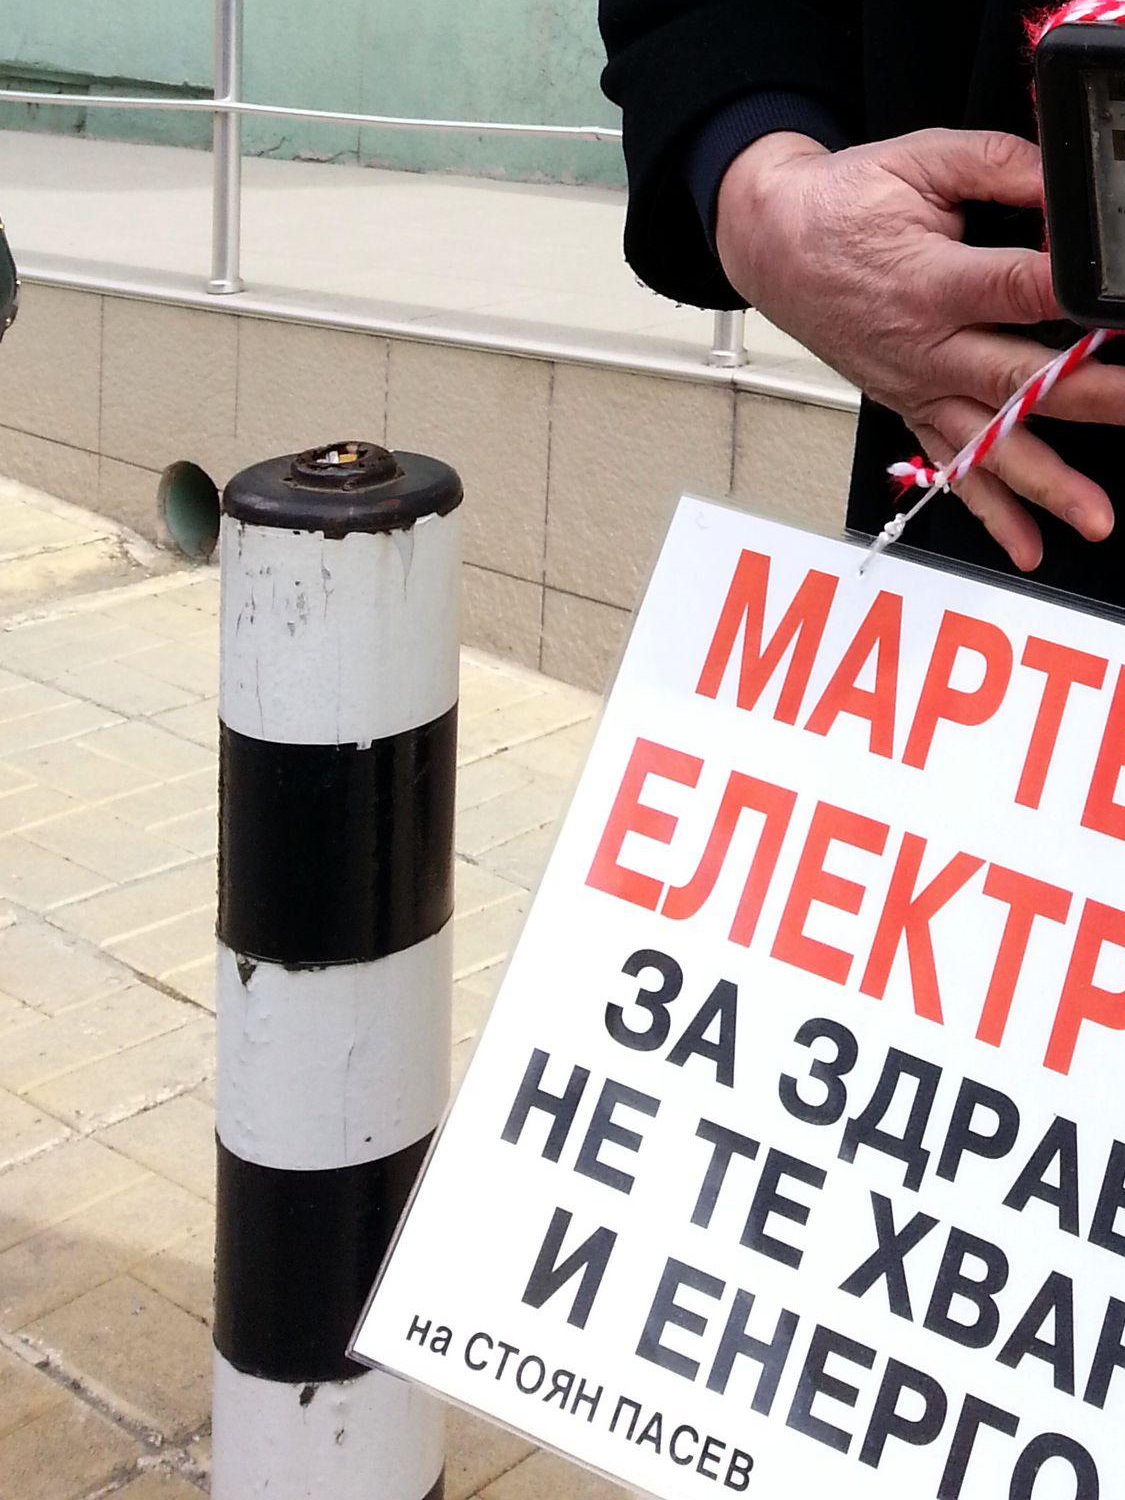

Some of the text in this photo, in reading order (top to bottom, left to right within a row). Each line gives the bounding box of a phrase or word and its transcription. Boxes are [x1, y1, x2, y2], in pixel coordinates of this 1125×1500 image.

[605, 949, 737, 1088] ЗА
[502, 1048, 661, 1194] НЕ
[693, 1118, 827, 1269] ТЕ
[522, 1207, 617, 1329] И
[407, 1315, 753, 1491] на СТОЯН ПАСЕВ
